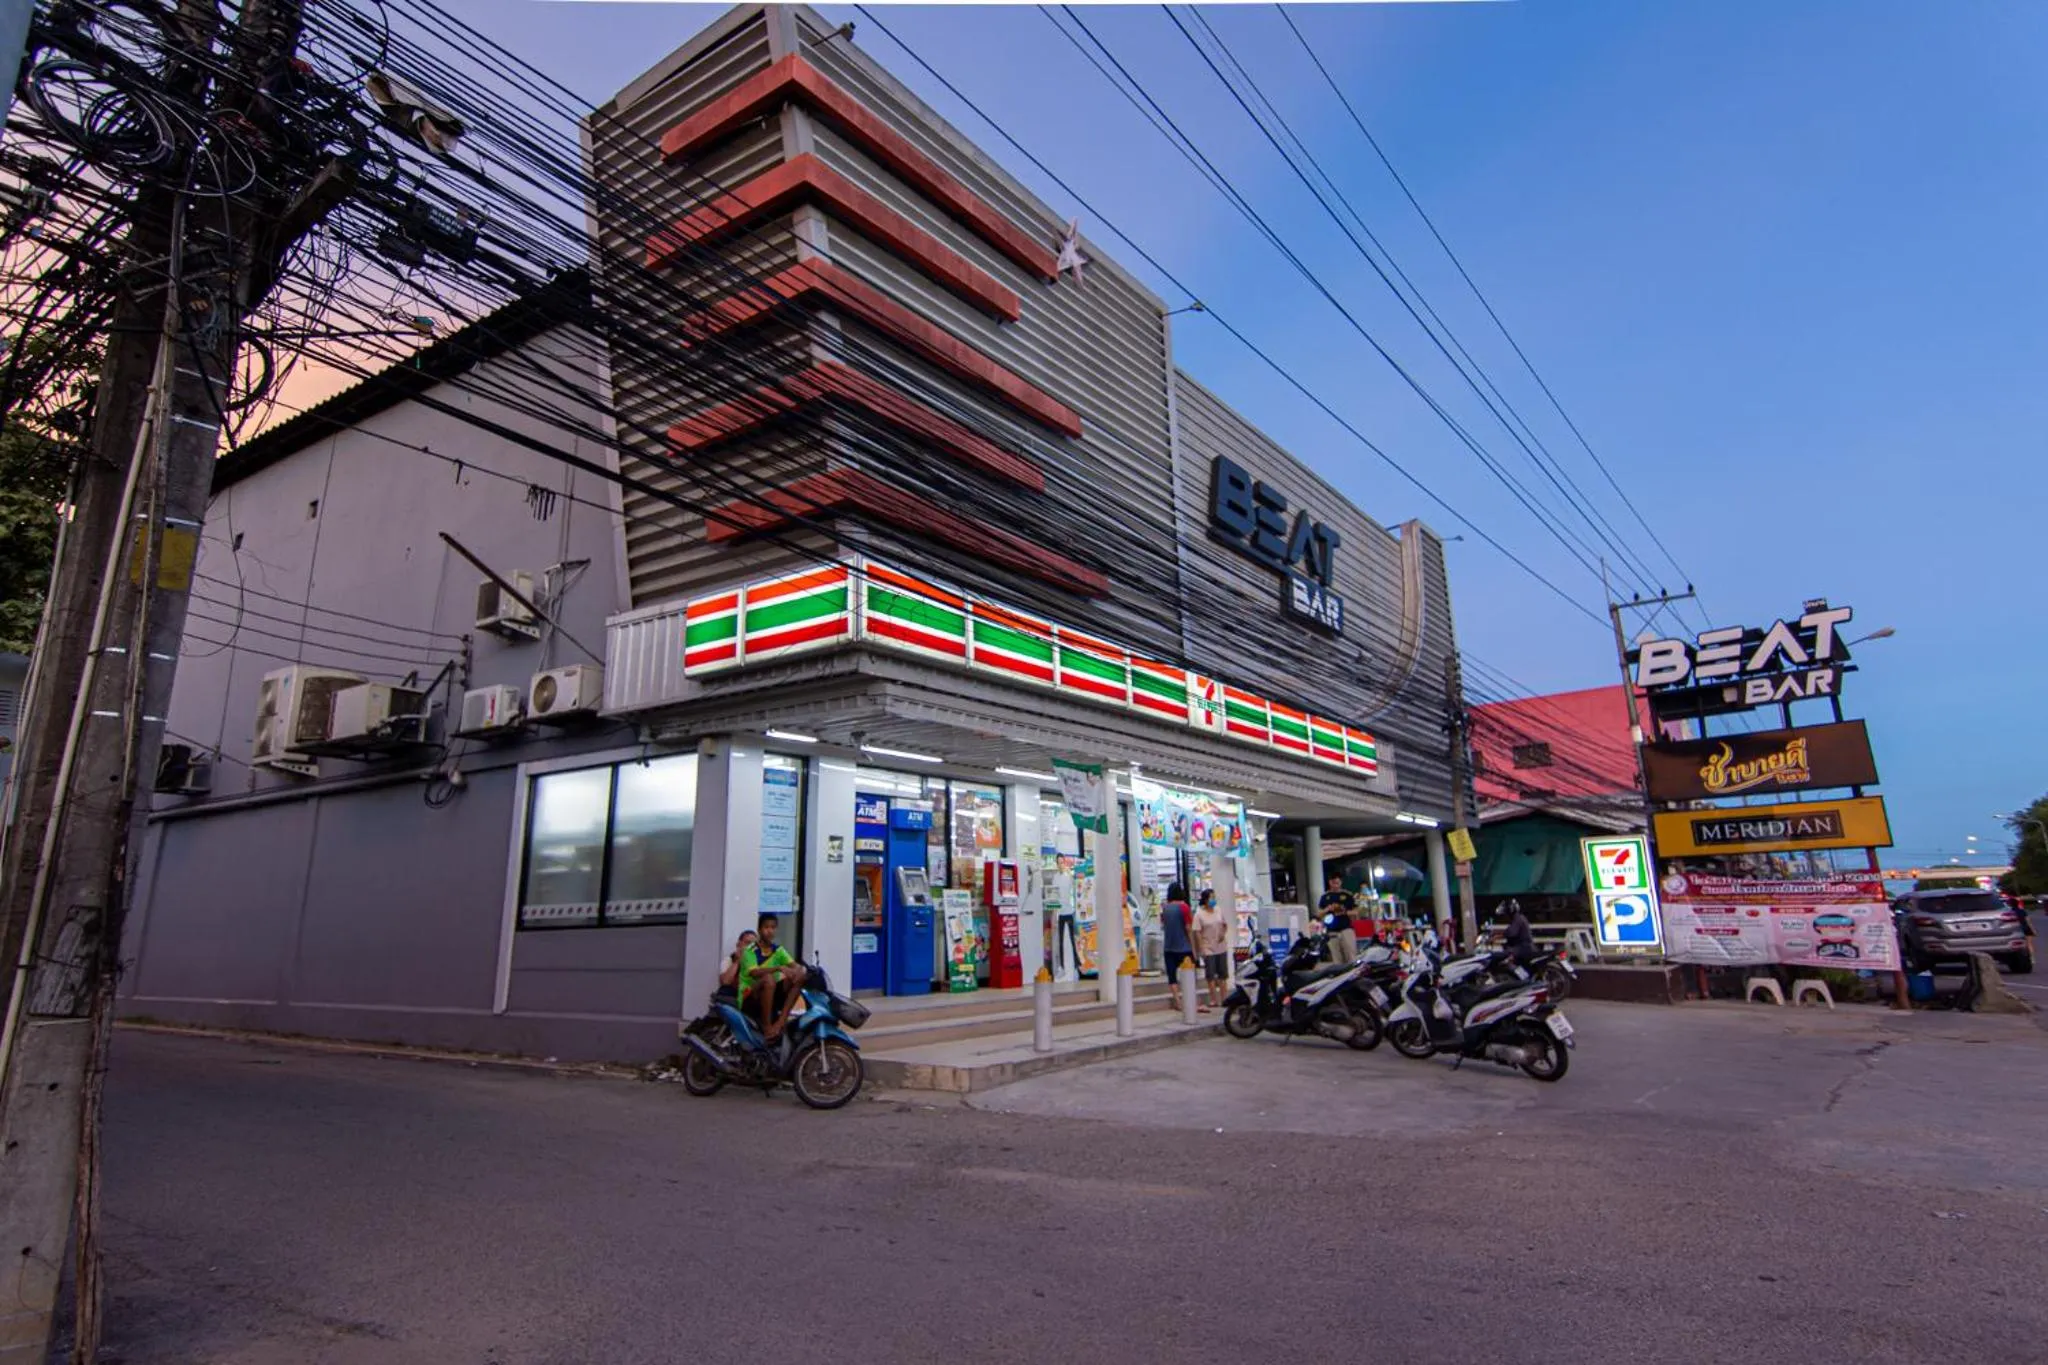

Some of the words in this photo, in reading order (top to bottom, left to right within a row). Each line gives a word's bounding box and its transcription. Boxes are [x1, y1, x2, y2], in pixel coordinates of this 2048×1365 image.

[1209, 454, 1341, 587] BEAT
[1291, 577, 1341, 631] BAR
[1637, 606, 1853, 687] BEAT
[1744, 669, 1834, 705] BAR
[907, 811, 924, 822] ATM
[1701, 816, 1834, 842] MERIDIAN
[1599, 848, 1631, 886] 7
[1600, 894, 1650, 942] P
